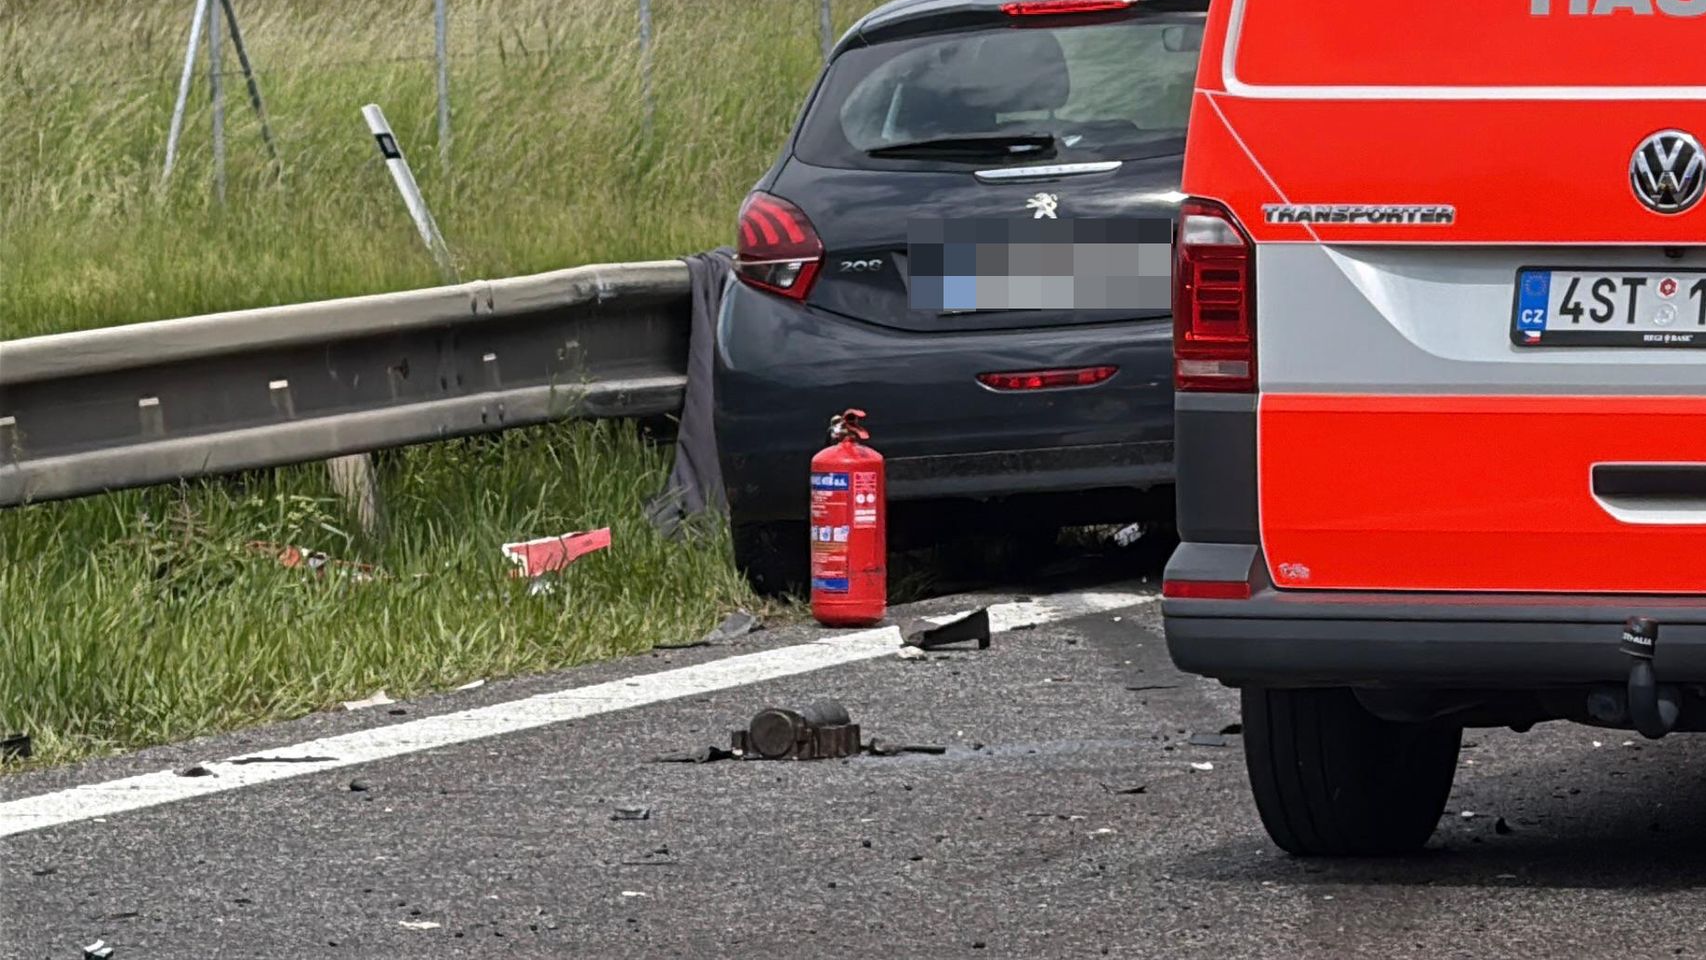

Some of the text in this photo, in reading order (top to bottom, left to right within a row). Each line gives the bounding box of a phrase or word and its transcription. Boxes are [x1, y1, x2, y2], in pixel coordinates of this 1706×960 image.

[1263, 205, 1456, 224] TRANSPORTER
[1559, 277, 1647, 324] 4ST
[1521, 308, 1545, 323] CZ
